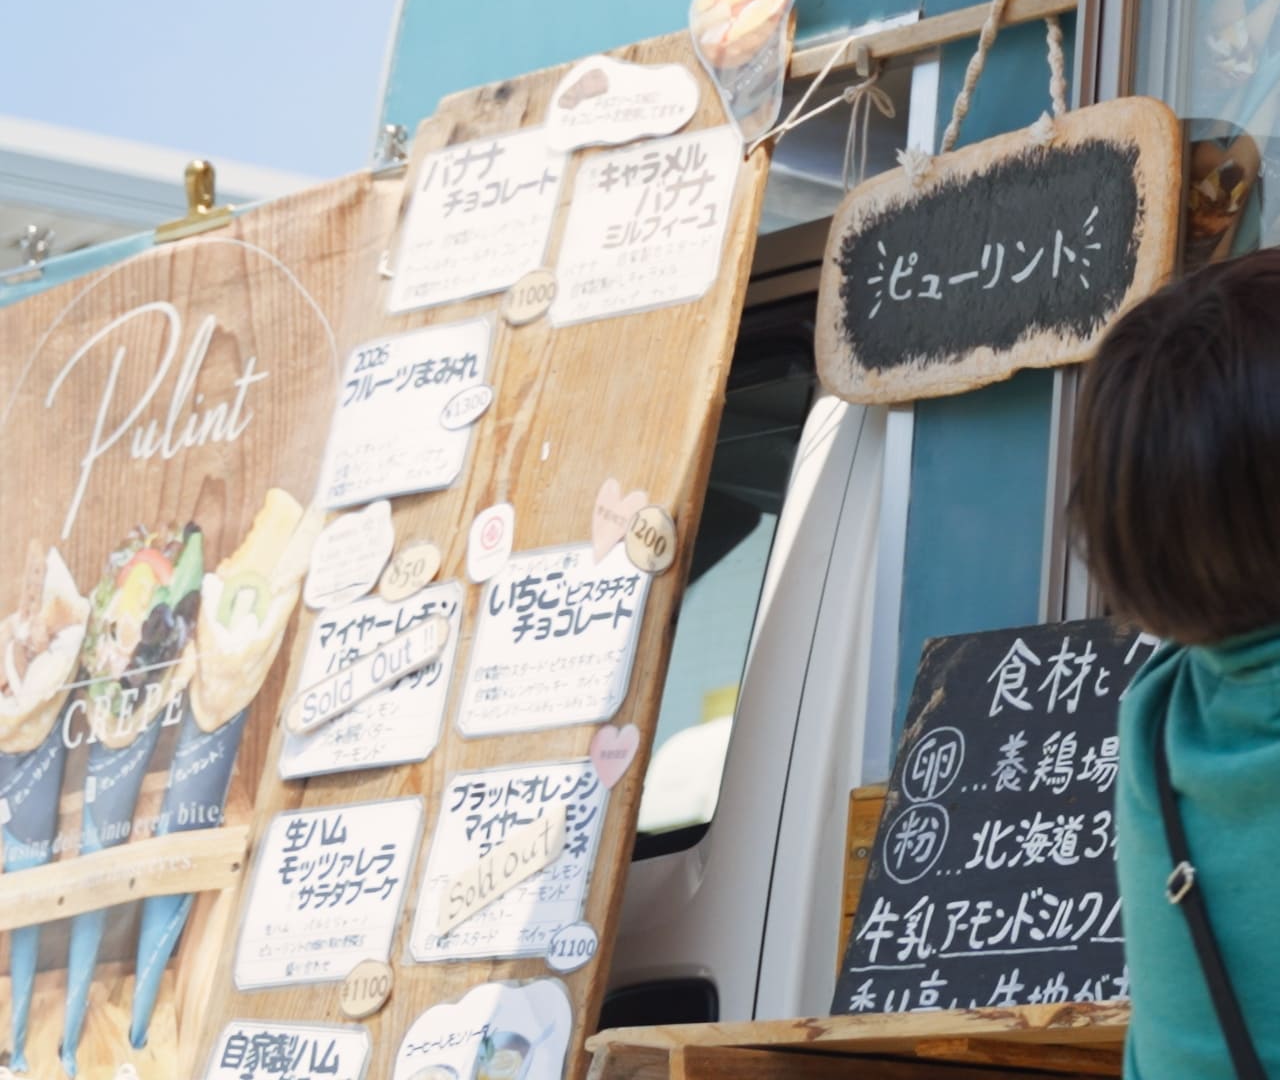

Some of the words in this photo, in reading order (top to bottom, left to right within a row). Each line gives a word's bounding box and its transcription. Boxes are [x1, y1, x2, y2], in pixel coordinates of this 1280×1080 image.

[423, 141, 505, 192] バナナ
[598, 143, 707, 192] キャラメル
[442, 168, 557, 218] チョコレート
[634, 168, 715, 217] バナナ
[602, 204, 718, 249] ミルフィーユ
[889, 228, 1077, 300] ピューリント
[343, 352, 478, 408] フルーツまみれ
[44, 300, 271, 542] Pulint
[512, 600, 633, 644] チョコレート
[302, 672, 354, 725] Sold
[371, 639, 413, 684] Out
[282, 813, 348, 853] 生ハム
[465, 804, 598, 842] マイヤーモン
[278, 843, 397, 885] モッツァレラ
[449, 861, 496, 919] Sold
[504, 819, 553, 878] out
[551, 938, 595, 957] ¥1100
[219, 1029, 340, 1074] 自家製ハム
